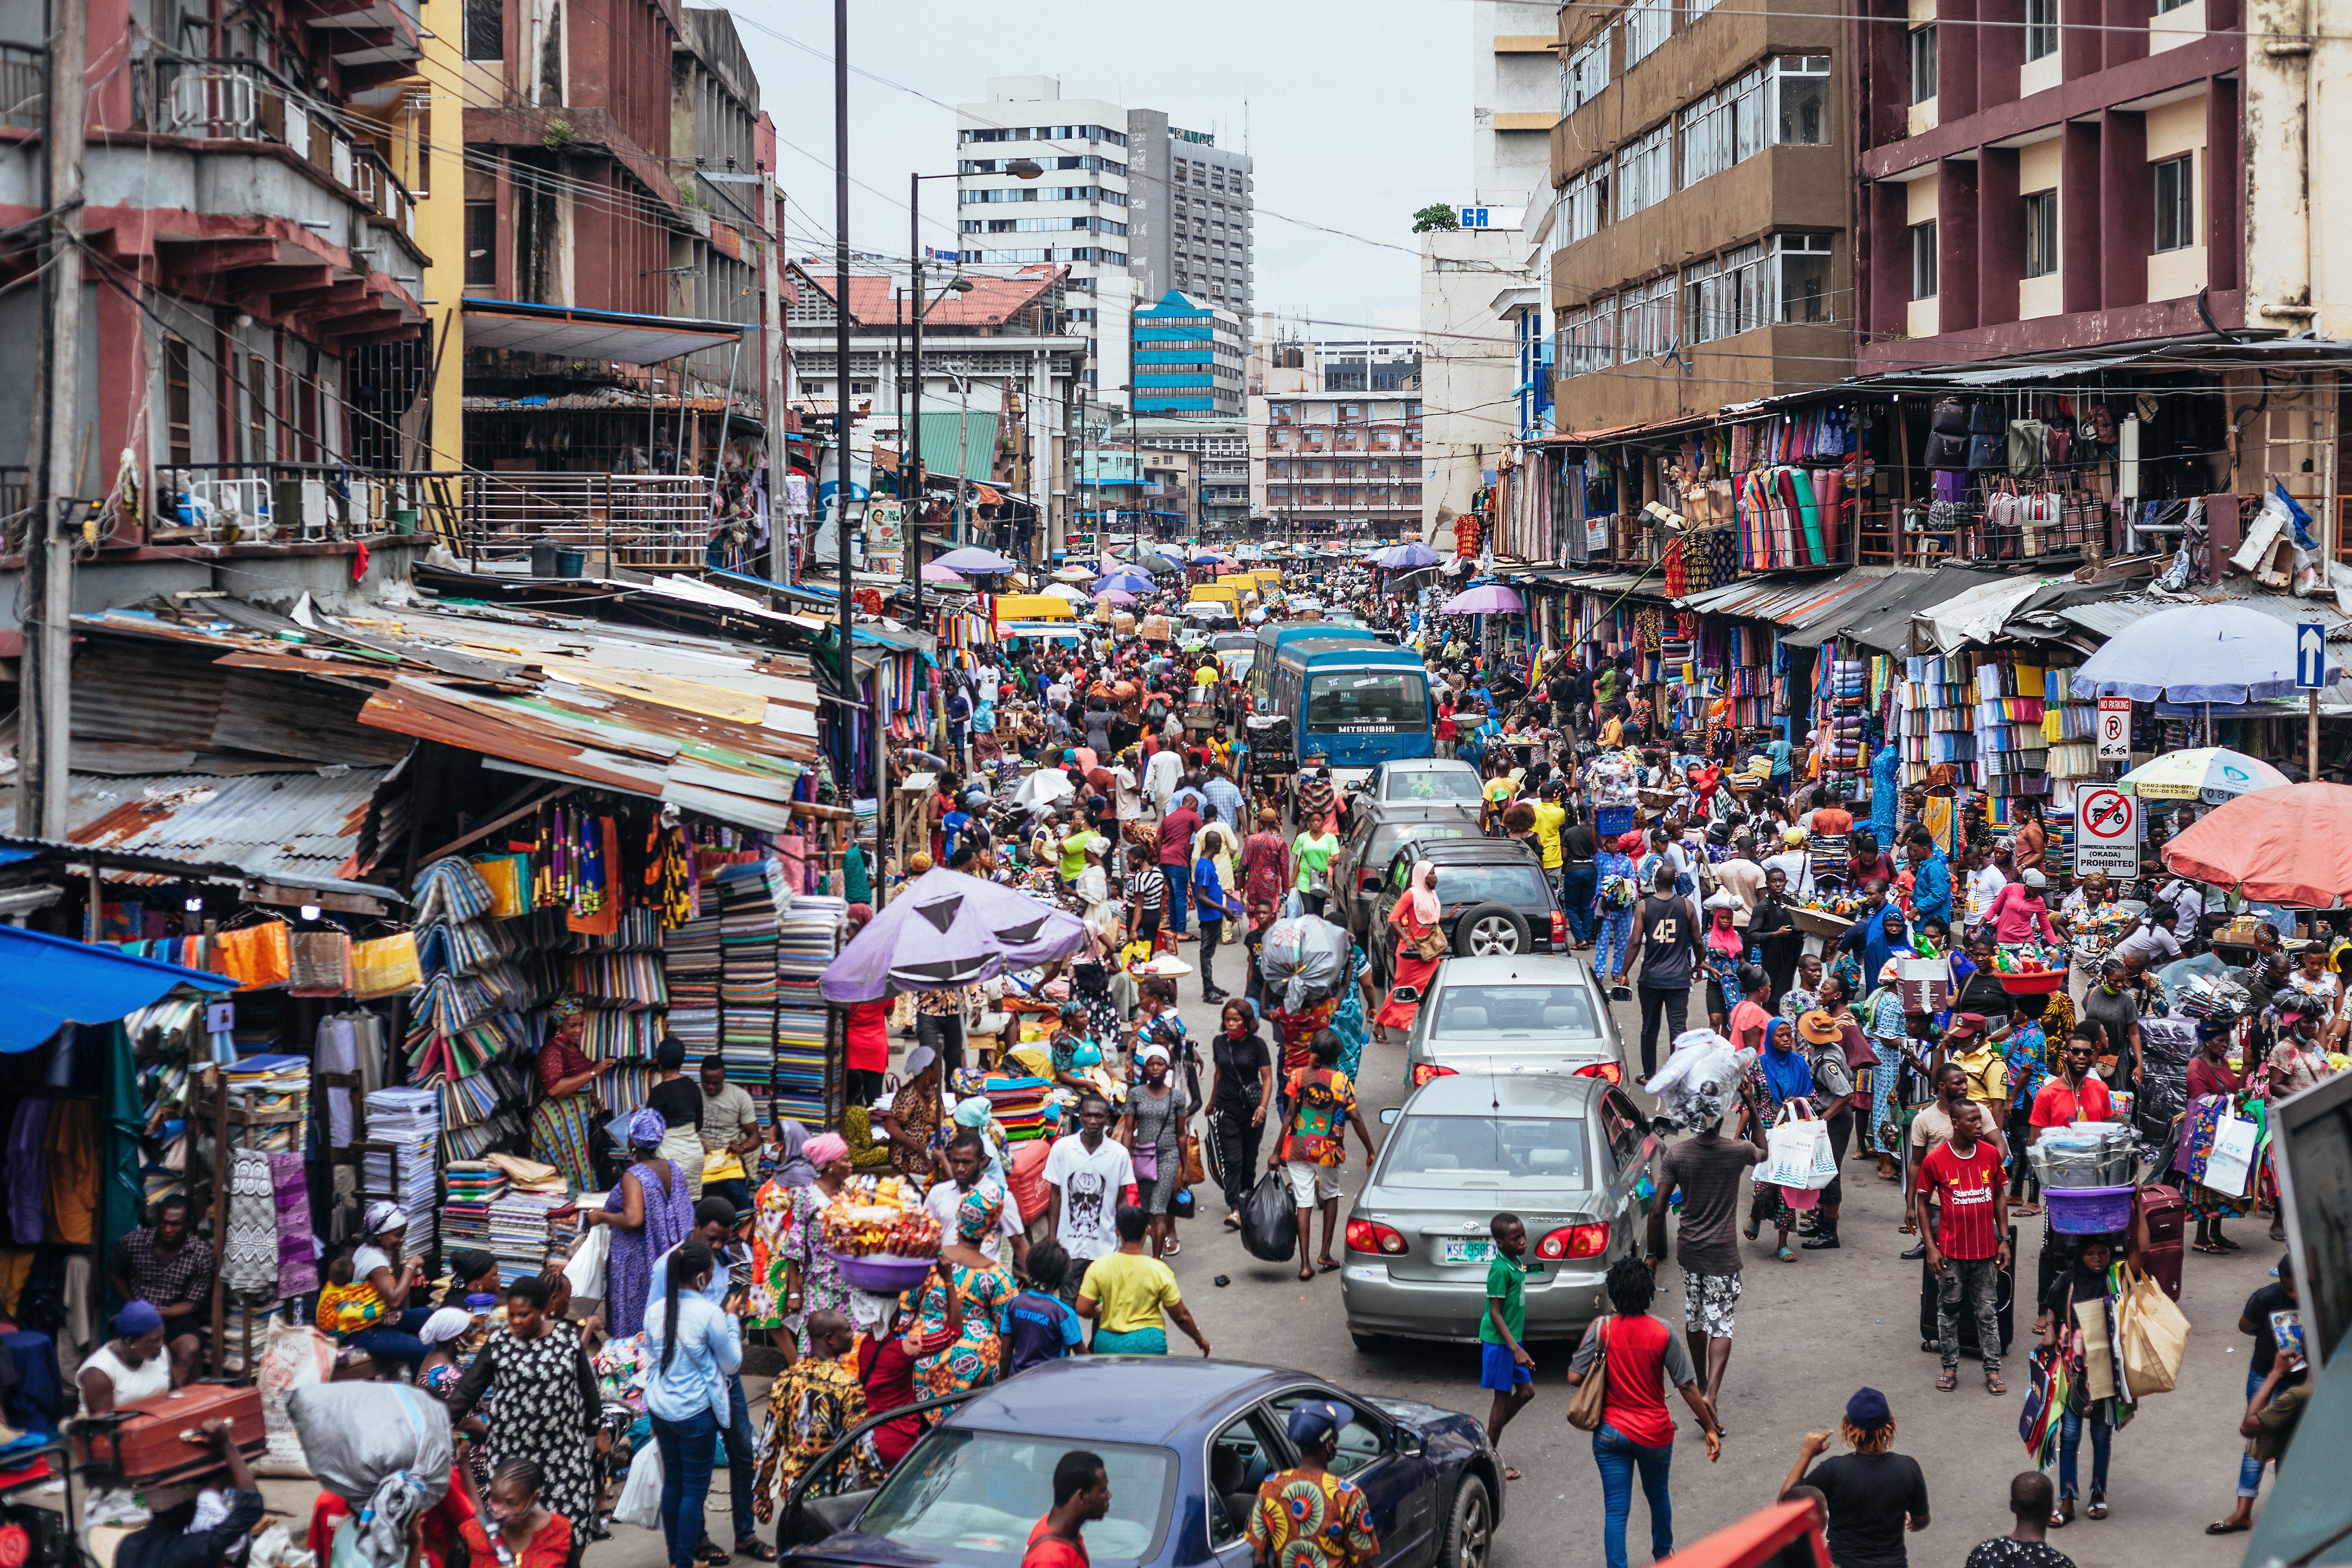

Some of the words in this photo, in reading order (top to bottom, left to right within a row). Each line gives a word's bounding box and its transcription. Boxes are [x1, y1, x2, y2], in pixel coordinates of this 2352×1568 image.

[1462, 208, 1488, 226] GR
[2100, 700, 2107, 709] NO
[2109, 700, 2129, 709] PARKING
[2081, 859, 2134, 867] PROHIBITED
[1653, 919, 1676, 943] 42
[1953, 1187, 1984, 1198] Standard
[1952, 1196, 1985, 1205] Chartered
[1447, 1244, 1465, 1257] KSF
[1015, 1308, 1050, 1327] VICTORIA
